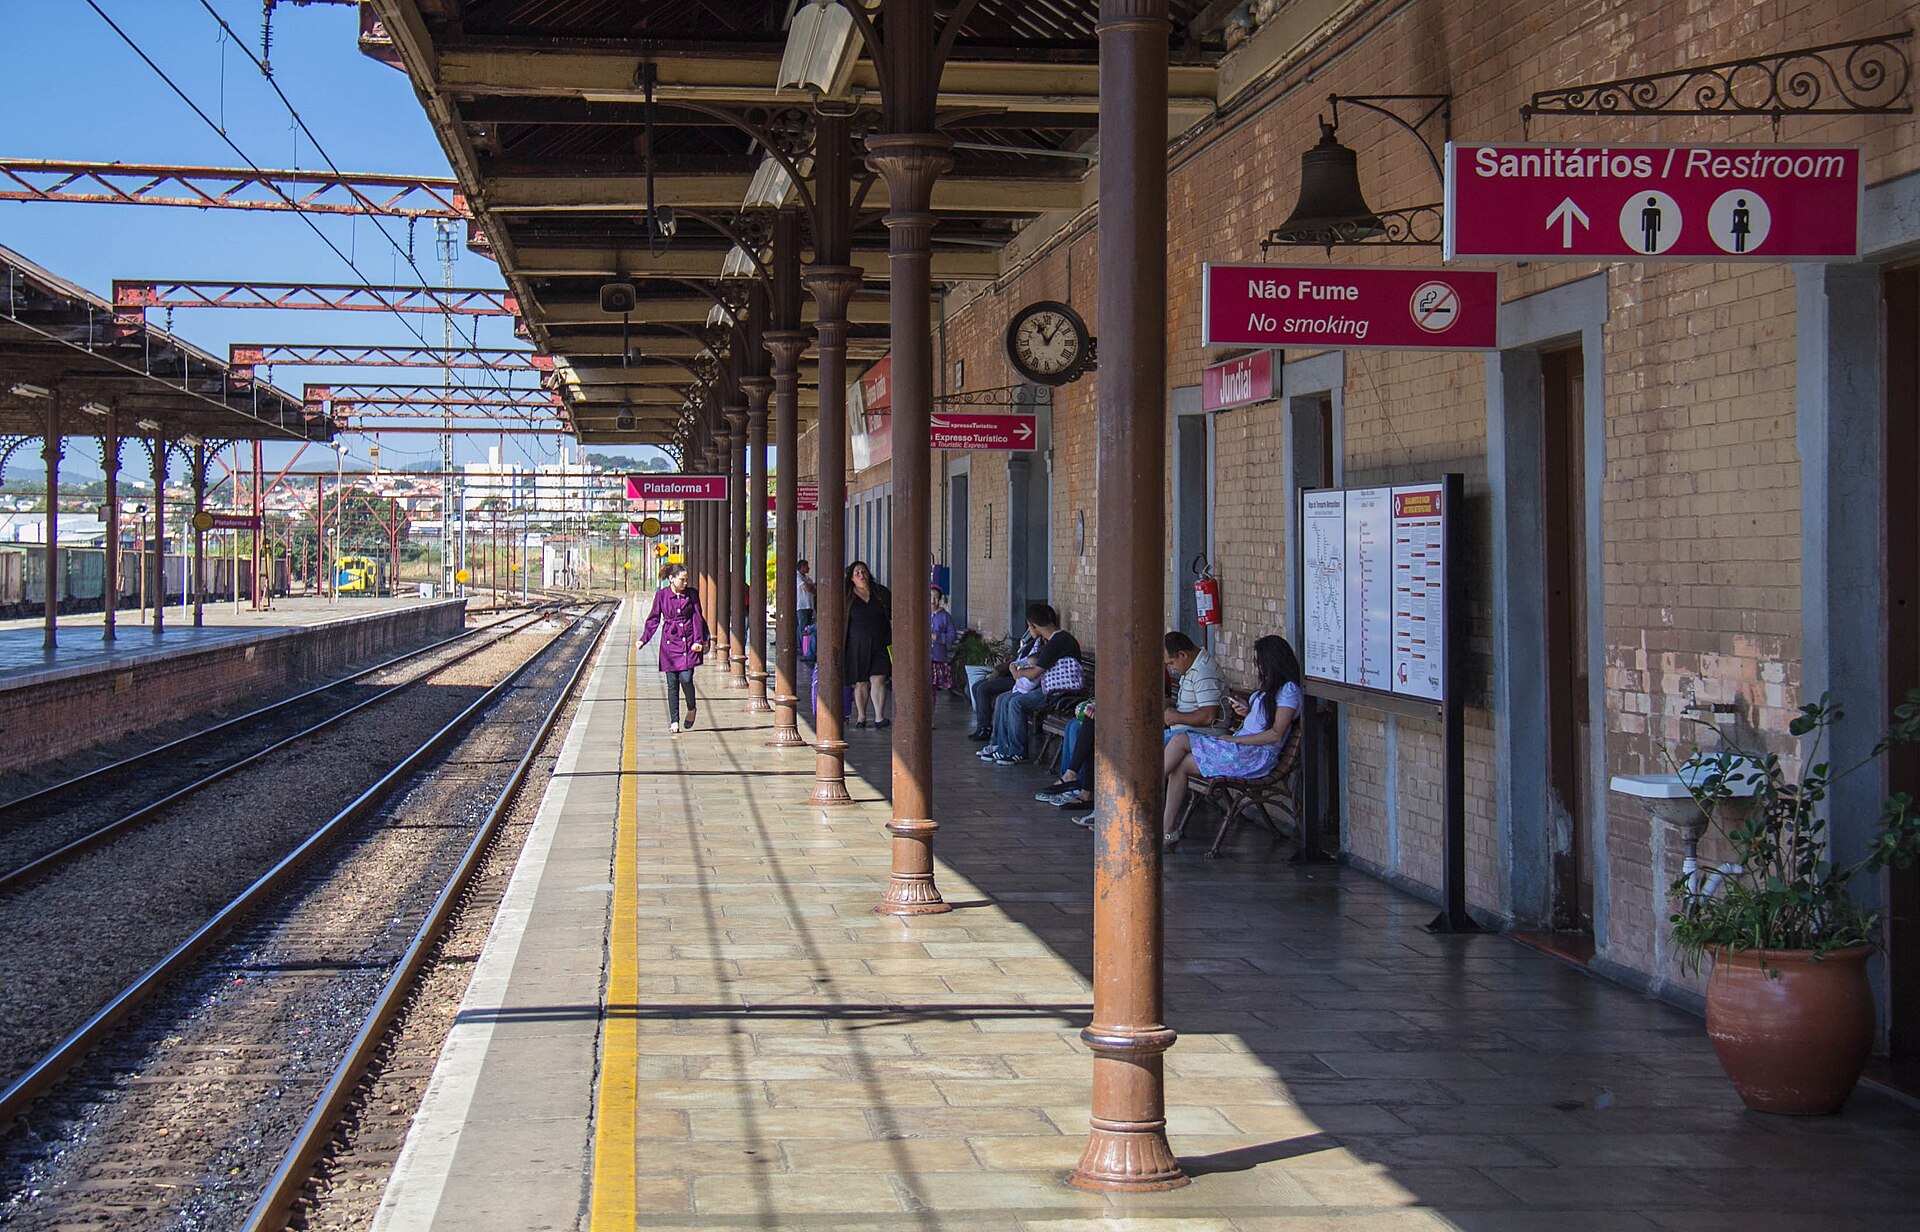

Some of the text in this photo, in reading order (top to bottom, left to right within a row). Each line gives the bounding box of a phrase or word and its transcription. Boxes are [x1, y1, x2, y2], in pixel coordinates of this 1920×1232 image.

[1475, 147, 1844, 179] Sanitários / Restroom
[1248, 280, 1359, 300] Não Fume
[1247, 313, 1369, 339] No smoking
[1219, 356, 1253, 405] Jundiaí
[935, 433, 973, 442] Expresso
[963, 441, 988, 449] Express
[643, 483, 711, 494] Plataforma 1
